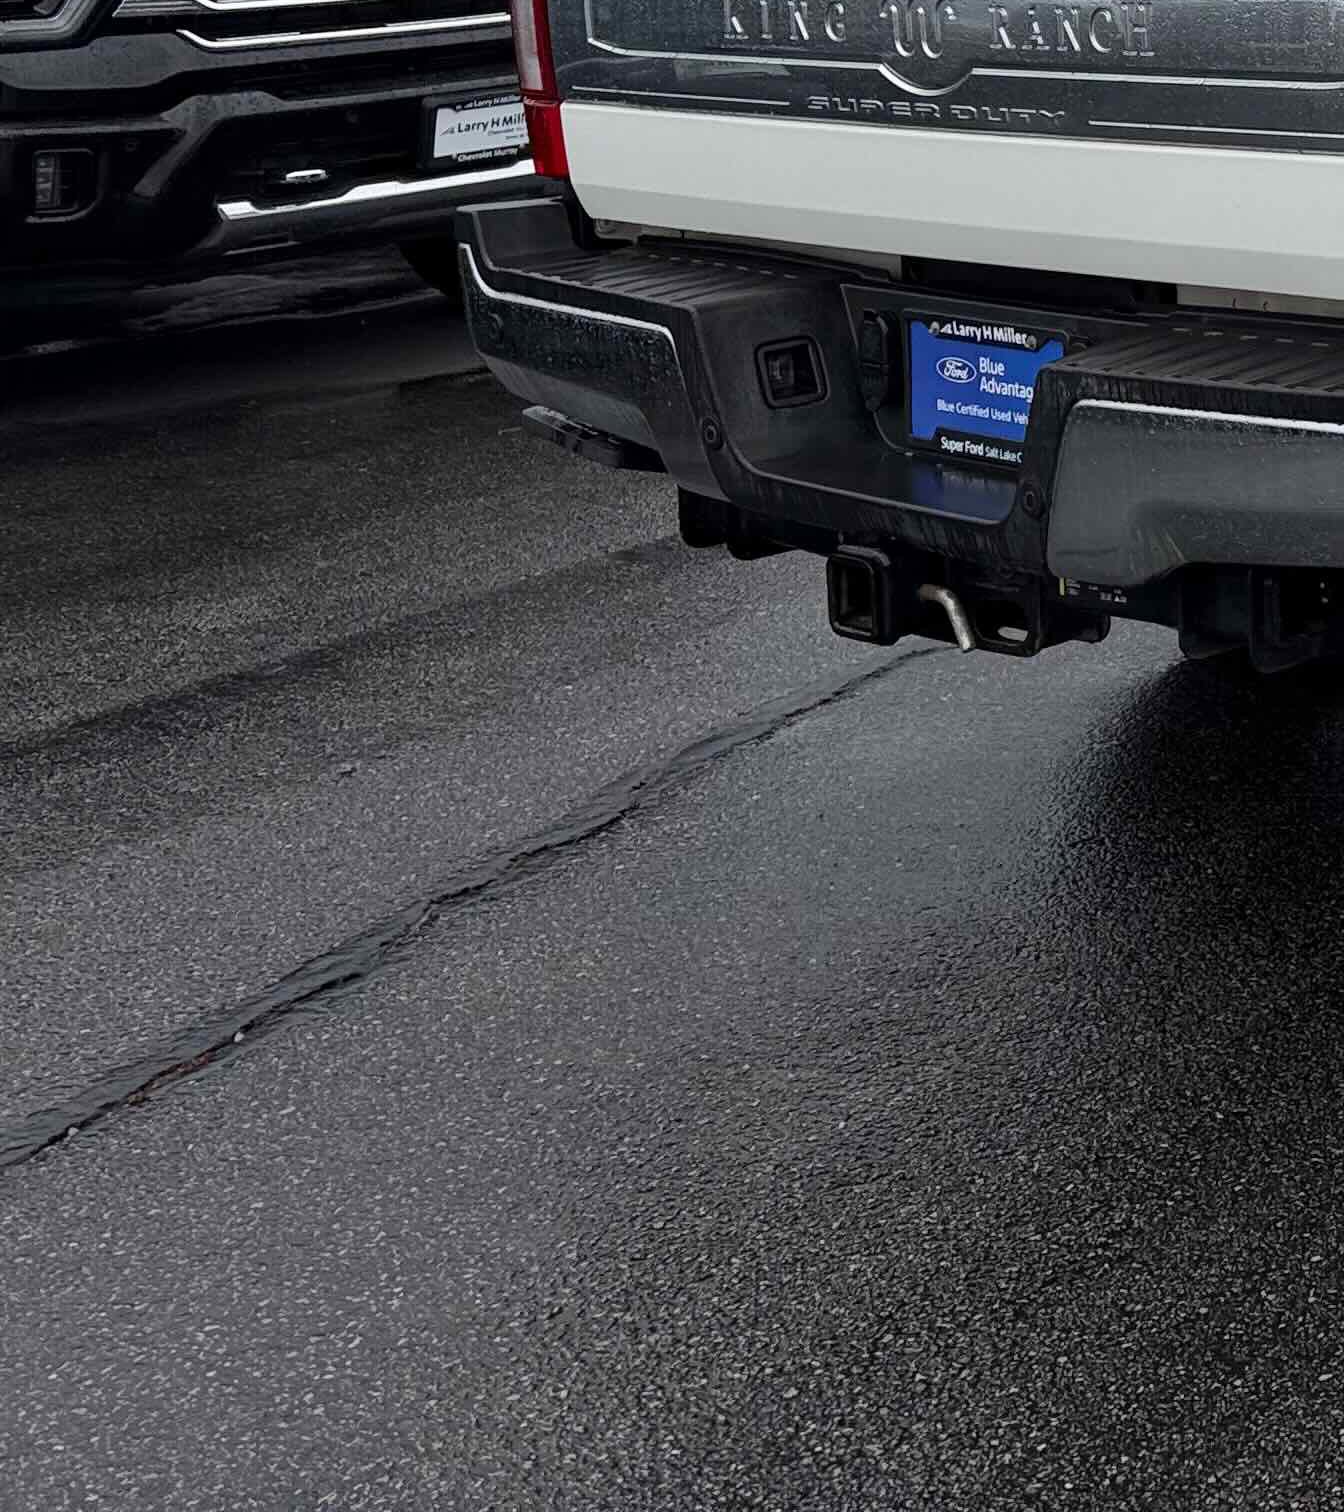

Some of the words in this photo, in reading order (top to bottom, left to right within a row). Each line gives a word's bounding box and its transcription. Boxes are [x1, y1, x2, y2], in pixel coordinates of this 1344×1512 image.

[987, 0, 1157, 58] RANCH
[807, 95, 941, 118] SUPER
[950, 104, 1065, 126] DUTY
[458, 121, 488, 133] Larry
[491, 118, 499, 128] H
[501, 113, 525, 126] Mill
[953, 321, 982, 342] Larry
[982, 326, 992, 340] H
[993, 326, 1027, 345] Miller
[943, 359, 969, 380] Ford
[979, 357, 1005, 376] Blue
[979, 378, 1034, 403] Advantag
[937, 399, 955, 413] Blue
[955, 401, 990, 419] Certified
[990, 407, 1012, 424] Used
[1013, 411, 1029, 425] Veh
[940, 436, 964, 453] Super
[965, 440, 984, 457] Ford
